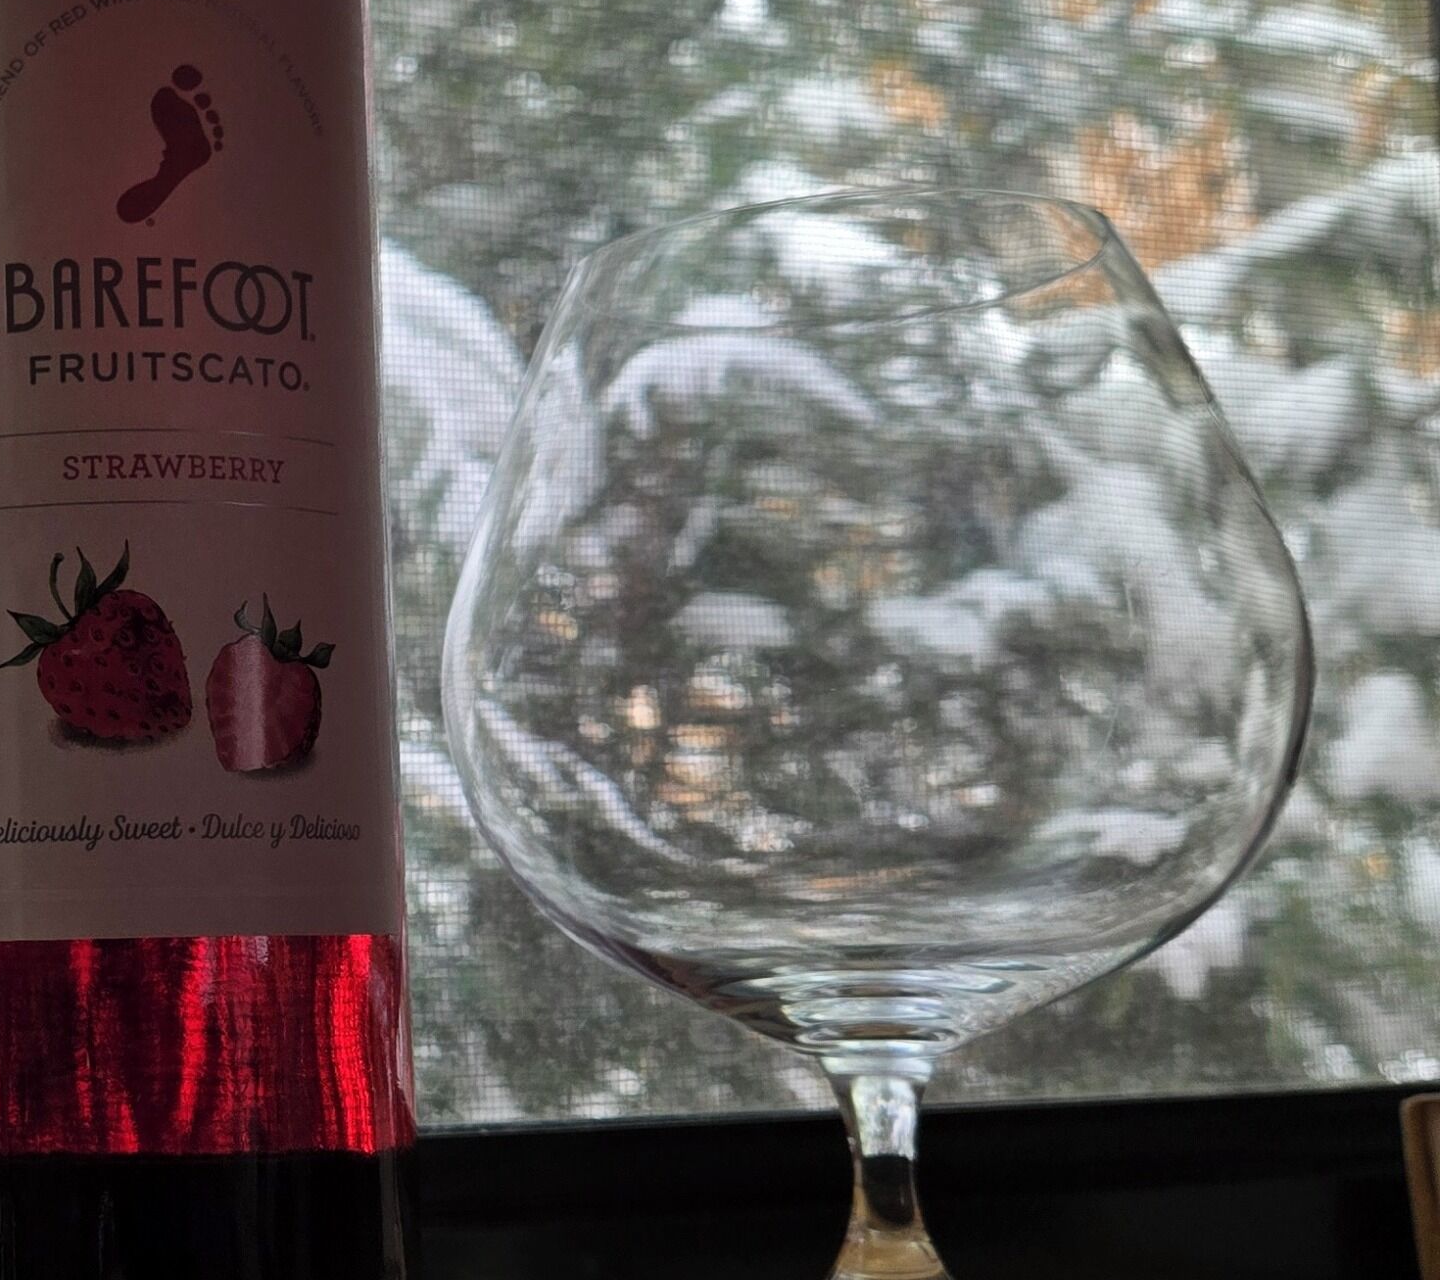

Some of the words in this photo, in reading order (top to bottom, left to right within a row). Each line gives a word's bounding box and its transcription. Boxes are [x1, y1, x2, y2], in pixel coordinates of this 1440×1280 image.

[24, 30, 47, 56] OF
[49, 4, 87, 35] RED
[5, 257, 314, 341] BAREFOOT
[29, 351, 306, 391] FRUITSCATO
[63, 454, 285, 484] STRAWBERRY
[109, 814, 183, 841] Sweet
[201, 813, 265, 839] Dulce
[270, 821, 286, 849] y
[289, 814, 360, 840] Delicioso
